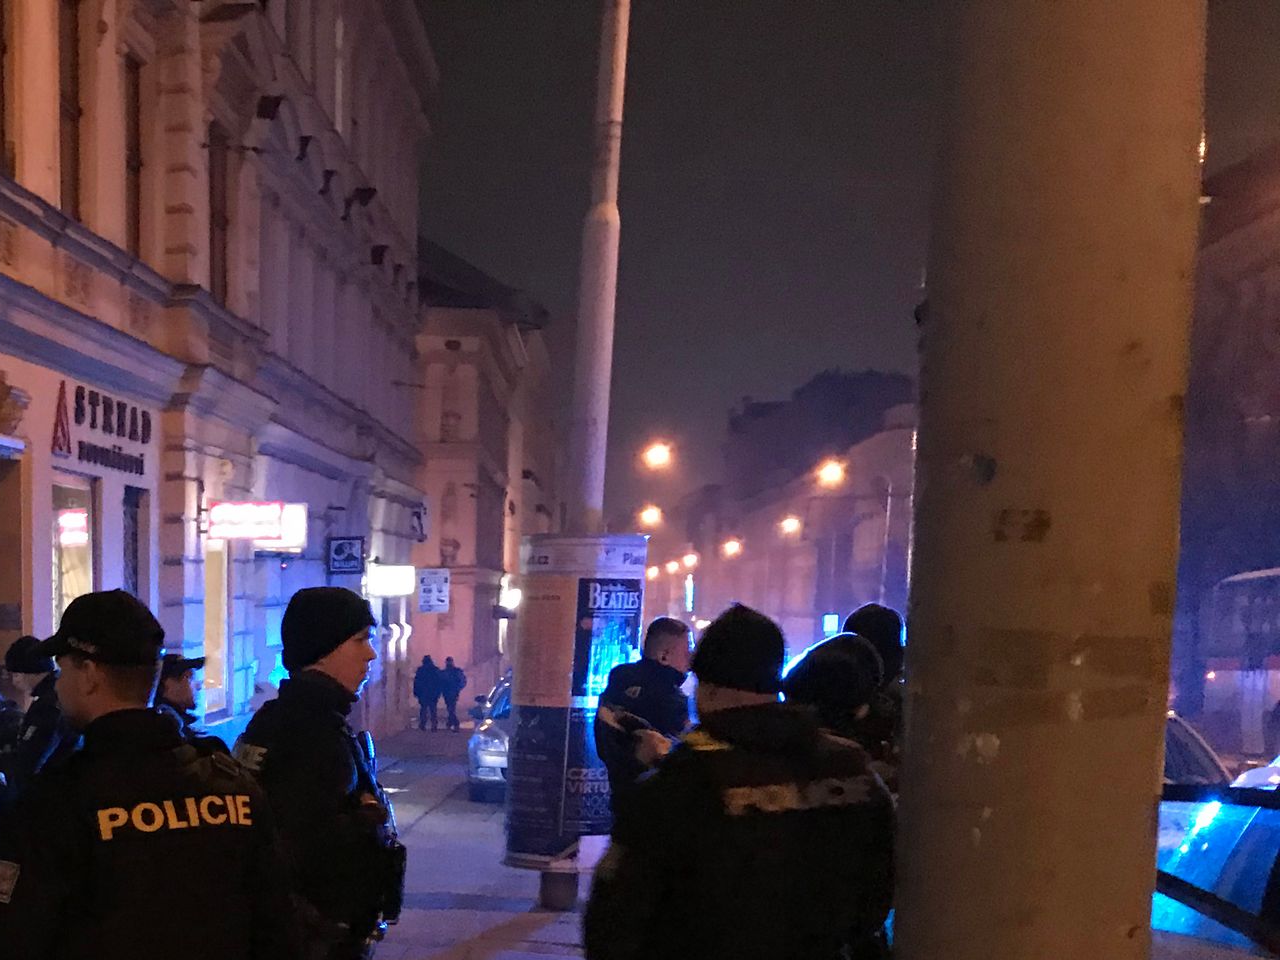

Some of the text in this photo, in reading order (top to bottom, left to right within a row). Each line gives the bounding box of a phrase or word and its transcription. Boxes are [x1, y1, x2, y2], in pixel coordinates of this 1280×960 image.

[588, 582, 640, 609] BEATLES
[567, 768, 608, 780] CZEC
[567, 780, 610, 793] VIRTU
[97, 795, 252, 841] POLICIE
